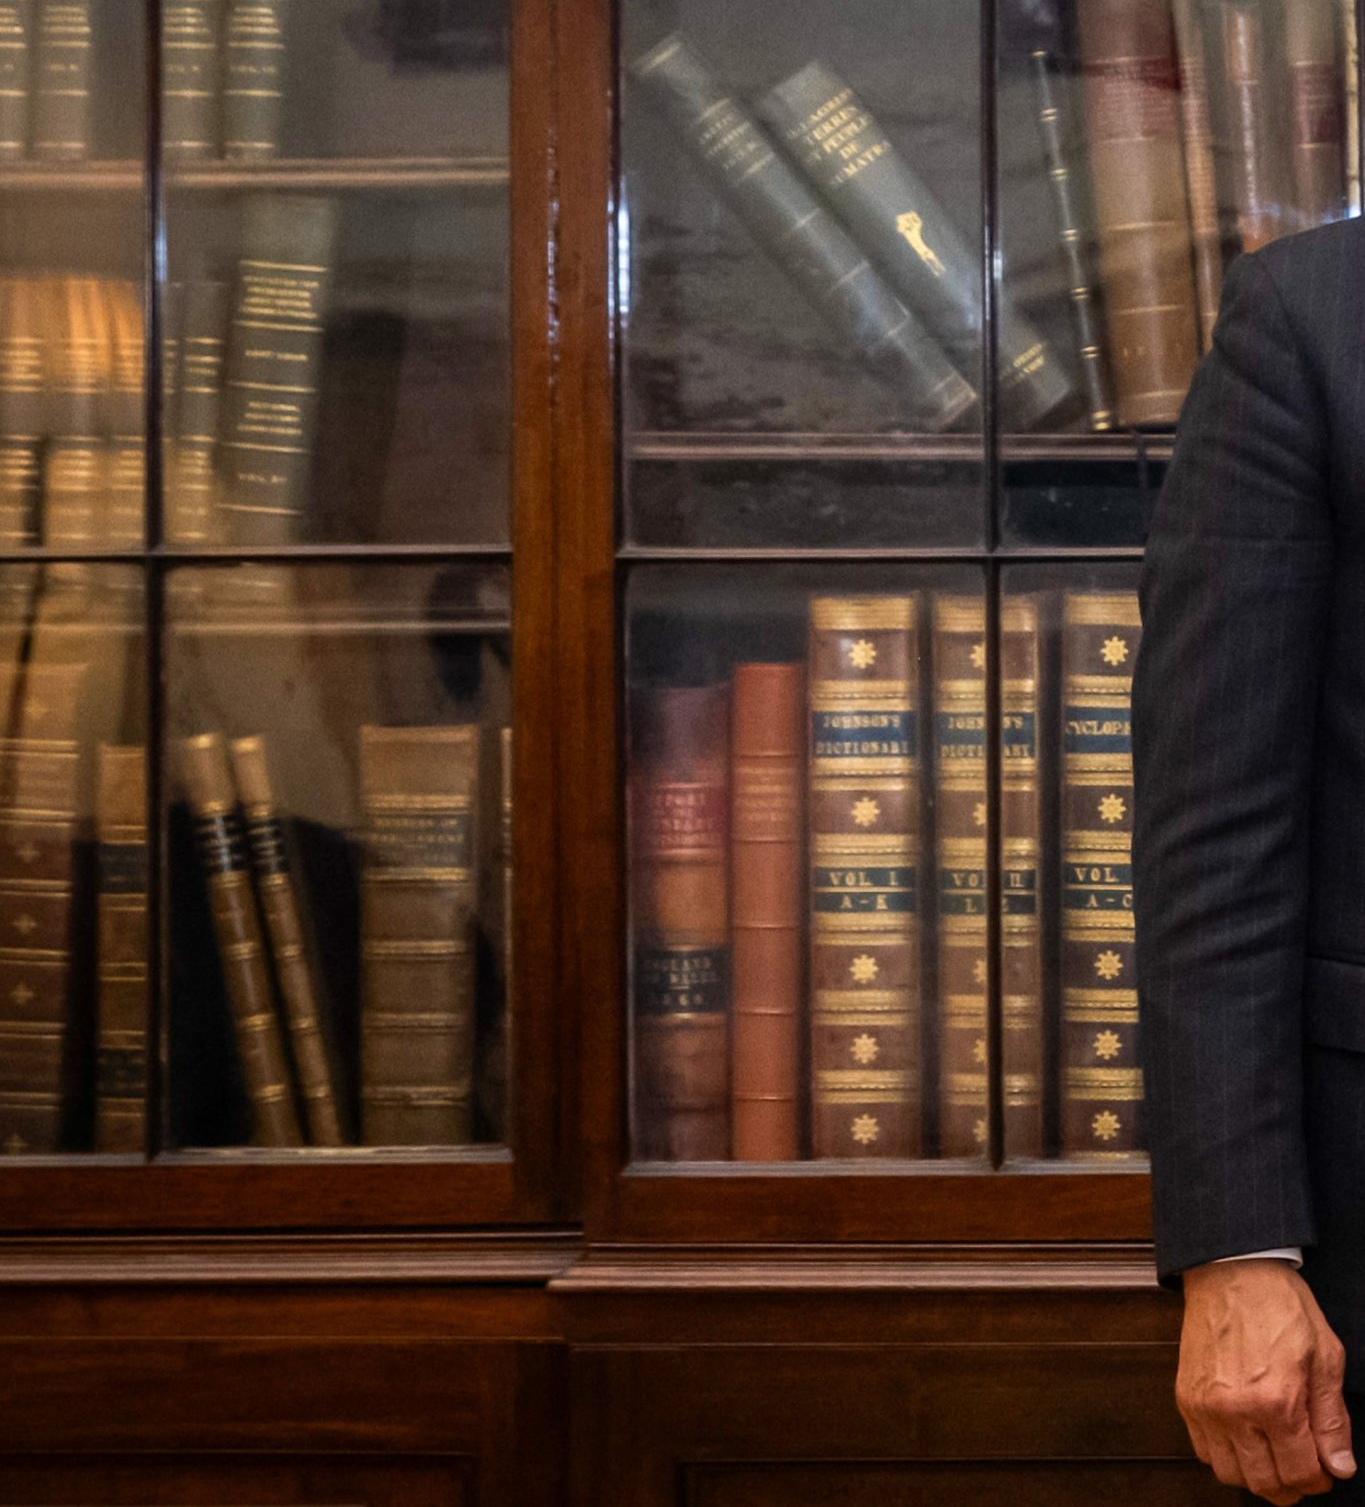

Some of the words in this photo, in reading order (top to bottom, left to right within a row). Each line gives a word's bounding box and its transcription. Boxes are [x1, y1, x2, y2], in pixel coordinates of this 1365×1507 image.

[822, 714, 901, 729] JOHNSON'S
[815, 740, 909, 754] DICTIONARY
[889, 871, 900, 886] I
